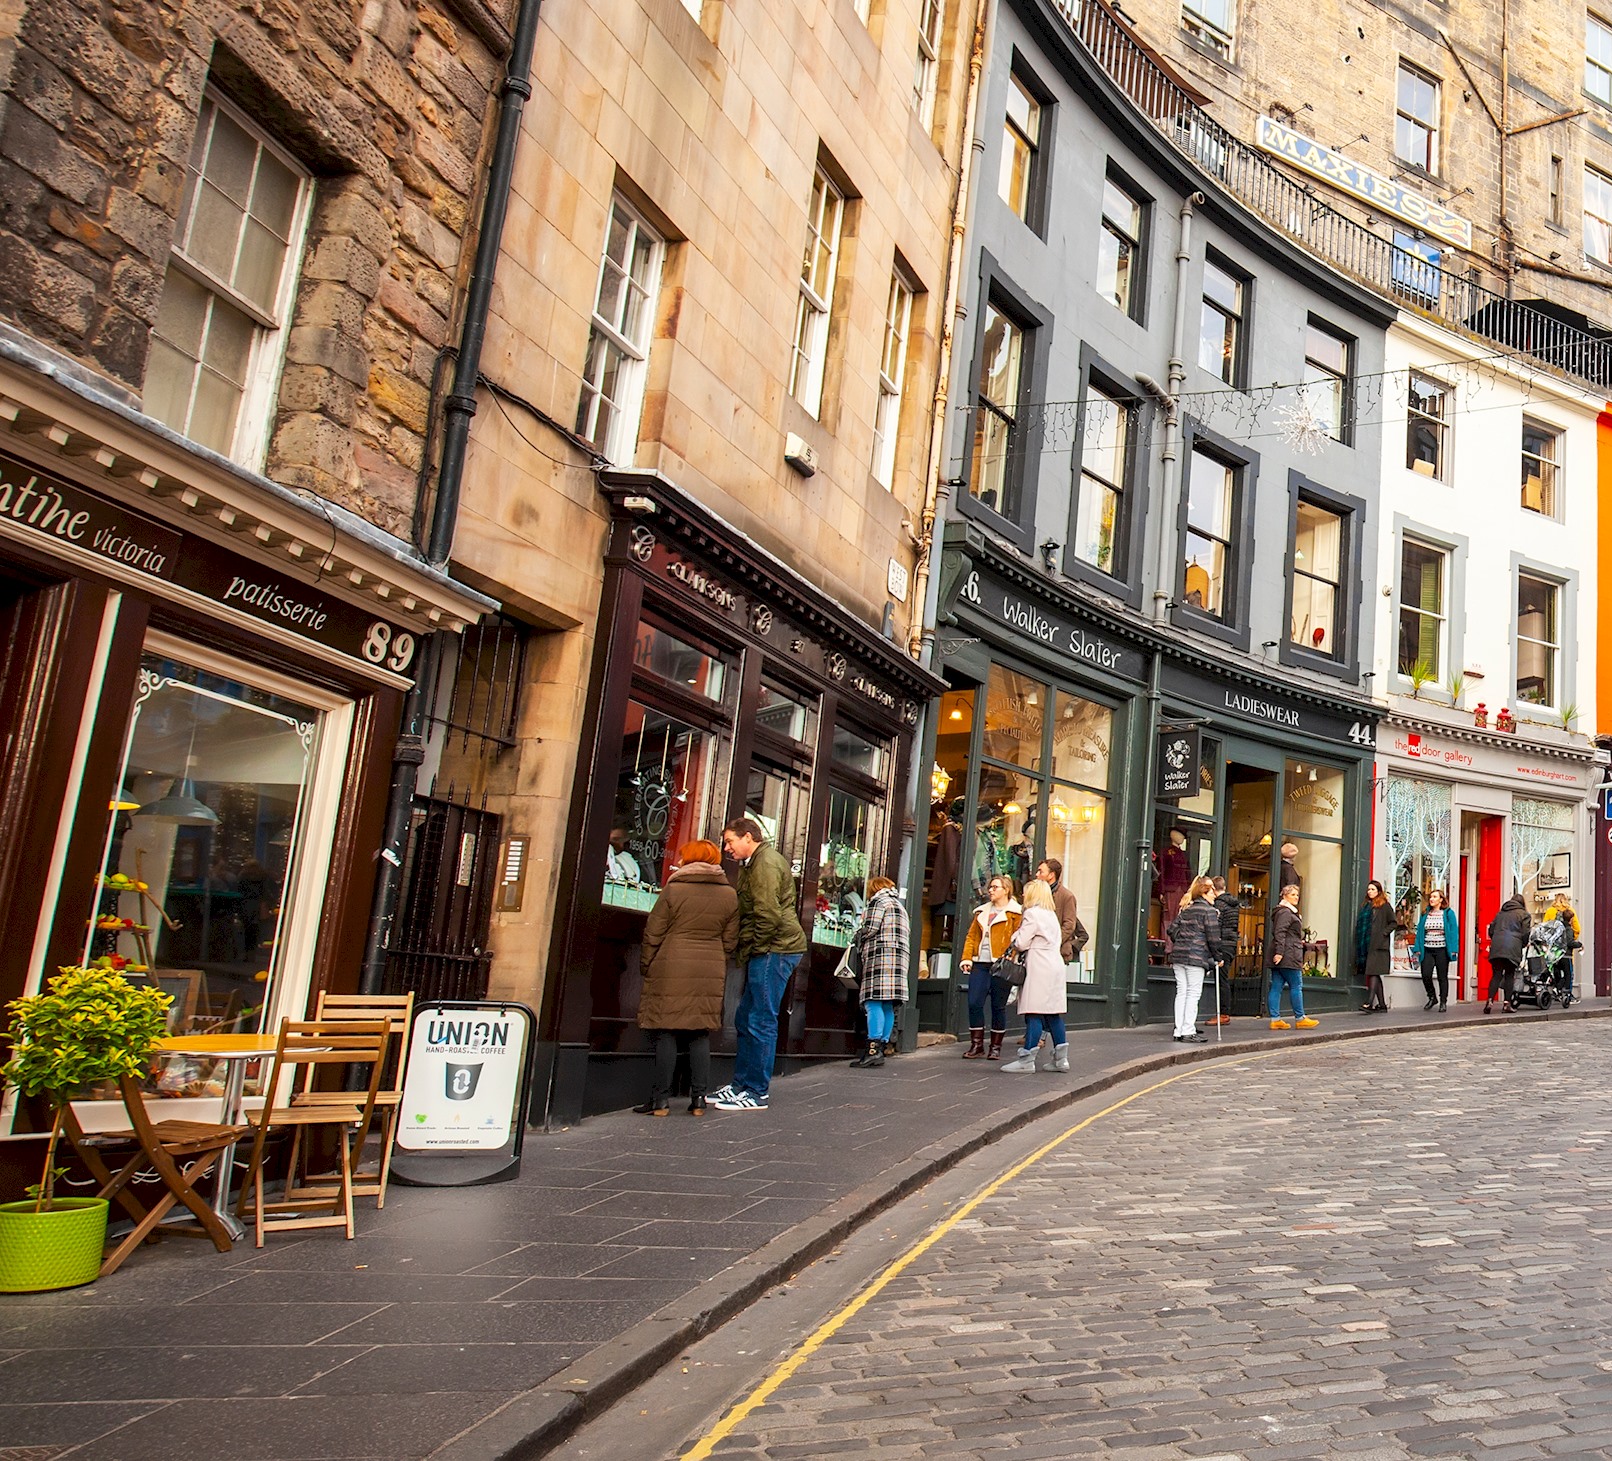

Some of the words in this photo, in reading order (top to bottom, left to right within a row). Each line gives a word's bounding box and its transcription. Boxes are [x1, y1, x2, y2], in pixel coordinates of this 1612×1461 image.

[1264, 122, 1430, 221] MAXIES
[93, 524, 166, 573] victoria
[223, 575, 329, 631] patisserie
[362, 621, 416, 673] 89
[1002, 596, 1060, 642] Walker
[1069, 629, 1122, 668] Slater
[1224, 691, 1300, 727] LADIESWEAR
[1394, 739, 1408, 752] the
[1408, 743, 1421, 754] red
[1421, 744, 1441, 758] door
[1444, 750, 1473, 766] gallery
[425, 1046, 478, 1054] HAND-ROAS
[480, 1047, 506, 1055] COFFEE
[428, 1021, 509, 1046] UNION
